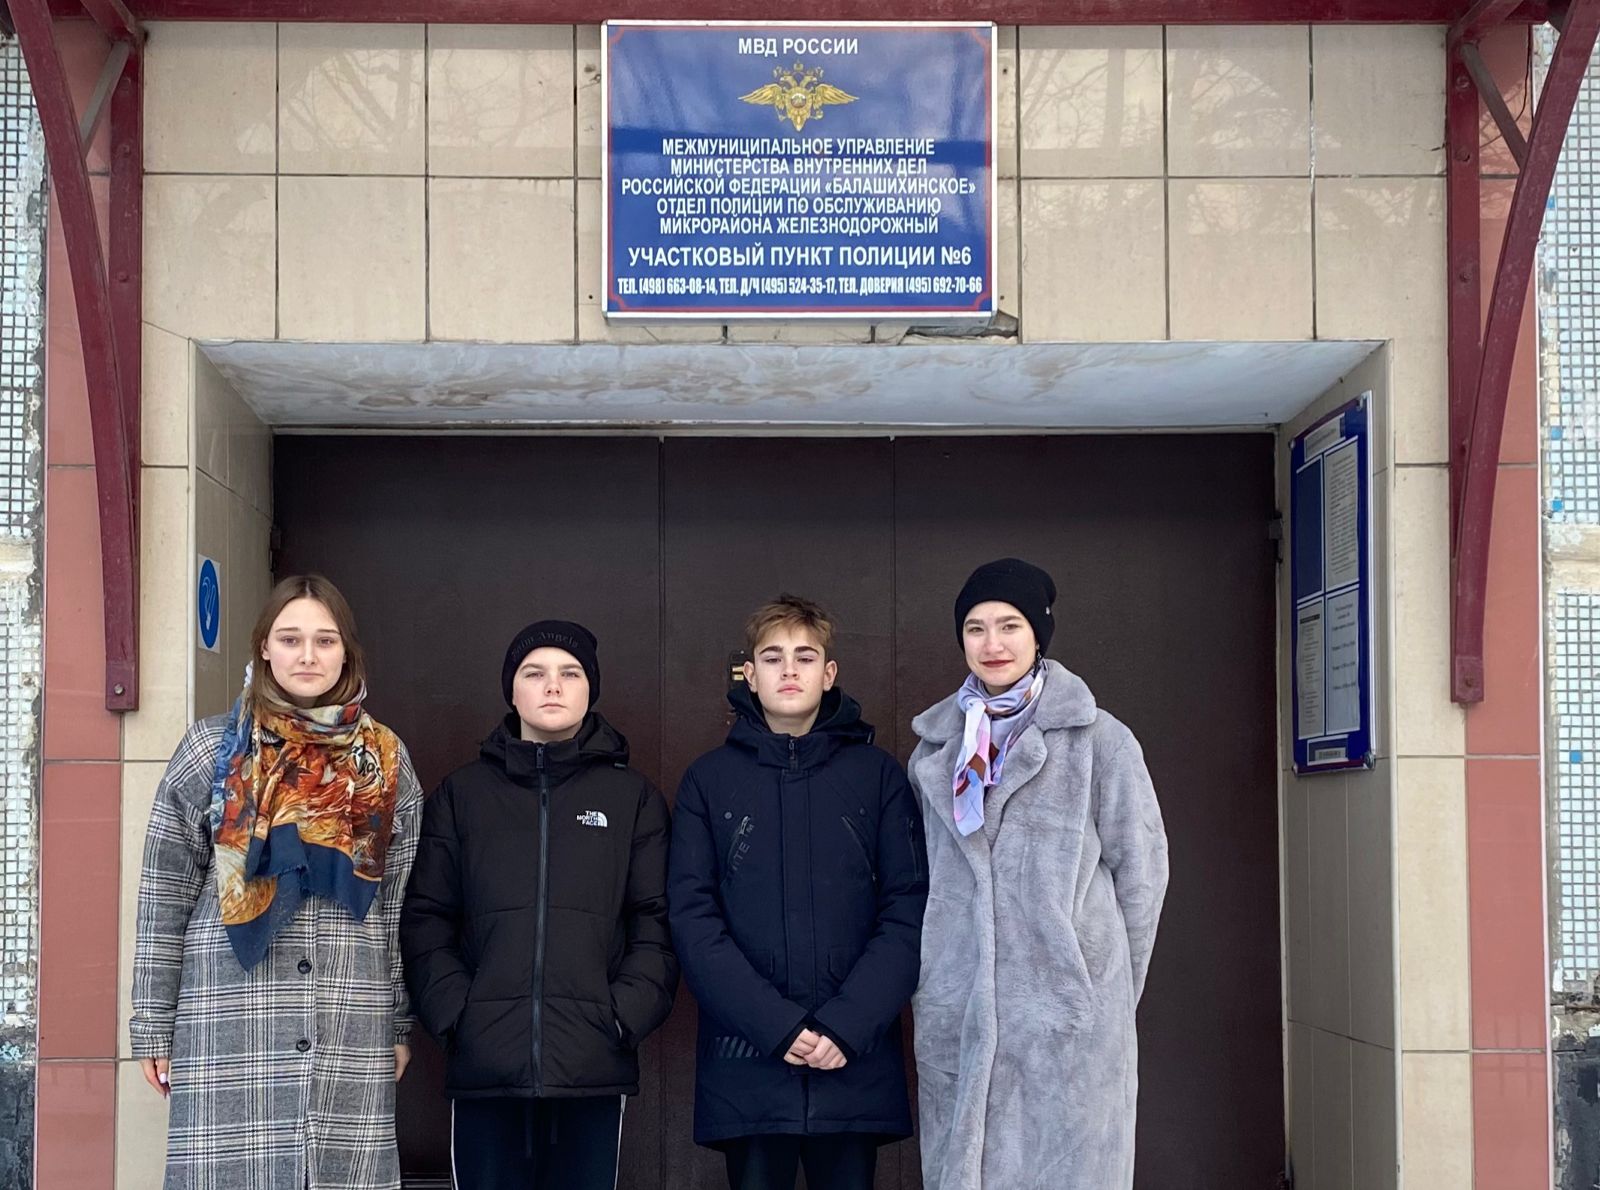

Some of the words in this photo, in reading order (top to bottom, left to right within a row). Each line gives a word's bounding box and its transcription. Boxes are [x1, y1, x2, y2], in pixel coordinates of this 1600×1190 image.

[738, 38, 778, 57] МВД
[783, 38, 858, 54] РОССИИ
[662, 138, 833, 158] МЕЖМУНИЦИПАЛЬНОЕ
[838, 138, 935, 155] УПРАВЛЕНИЕ
[670, 158, 789, 175] МИНИСТЕРСТВА
[794, 158, 893, 174] ВНУТРЕННИХ
[897, 158, 927, 177] ДЕЛ
[622, 174, 725, 195] РОССИЙСКОЙ
[729, 178, 821, 198] ФЕДЕРАЦИИ
[825, 178, 976, 195] «БАЛАШИХИНСКОЕ»
[656, 198, 706, 217] ОТДЕЛ
[710, 197, 783, 217] ПОЛИЦИИ
[788, 198, 808, 214] ПО
[812, 197, 942, 215] ОБСЛУЖИВАНИЮ
[660, 213, 773, 235] МИКРОРАЙОНА
[777, 213, 939, 236] ЖЕЛЕЗНОДОРОЖНЫЙ
[628, 242, 764, 267] УЧАСТКОВЫЙ
[770, 247, 833, 265] ПУНКТ
[839, 246, 935, 270] ПОЛИЦИИ
[941, 246, 971, 265] №6
[618, 278, 638, 294] ТЕЛ.
[639, 278, 665, 294] (498)
[666, 277, 718, 295] 663-08-14,
[719, 278, 739, 294] ТЕЛ.
[740, 277, 759, 296] Д/Ч
[762, 277, 787, 294] (495)
[789, 277, 837, 295] 524-35-17,
[839, 277, 858, 294] ТЕЛ.
[860, 277, 903, 296] ДОВЕРИЯ
[905, 277, 931, 294] (495)
[933, 276, 982, 293] 692-70-66
[576, 814, 598, 822] NORTH
